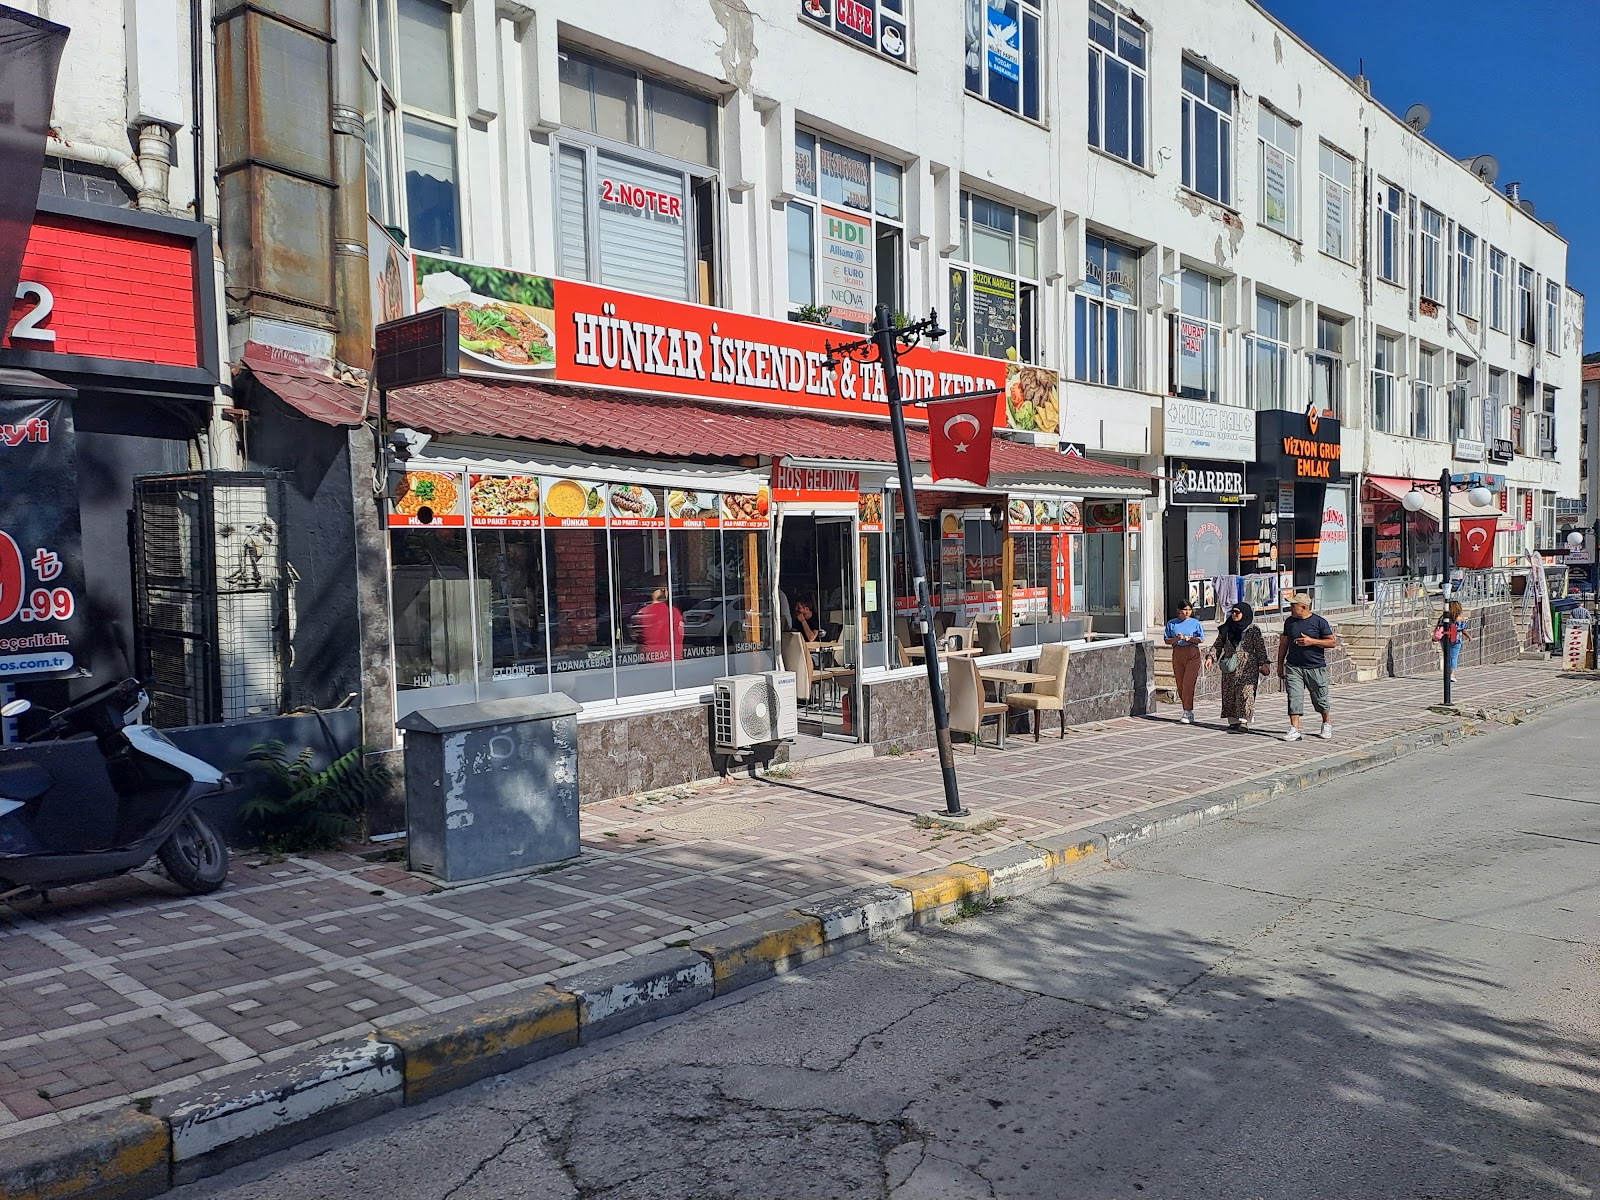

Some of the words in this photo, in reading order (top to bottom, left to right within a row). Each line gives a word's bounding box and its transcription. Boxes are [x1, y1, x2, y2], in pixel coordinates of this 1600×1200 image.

[837, 0, 873, 39] CAFE
[602, 179, 682, 218] 2.NOTER
[829, 218, 864, 245] HDI
[830, 244, 855, 260] Allianz
[844, 266, 864, 279] EURO
[973, 272, 992, 287] BOZOK
[12, 281, 57, 342] 2
[1182, 322, 1206, 339] MURAT
[574, 302, 706, 380] HÜNKAR
[709, 322, 836, 398] İSKENDER
[839, 354, 857, 400] &
[1179, 404, 1217, 429] MURAT
[1284, 436, 1318, 458] VİZYON
[1319, 442, 1341, 460] GRUP
[1297, 458, 1330, 478] EMLAK
[778, 468, 802, 497] HOŞ
[1188, 470, 1243, 494] BARBER
[473, 517, 486, 526] ALO
[487, 518, 507, 526] PAKET
[511, 519, 522, 527] 217
[523, 519, 532, 527] 30
[561, 518, 589, 527] HÜNKAR
[611, 519, 622, 527] ALO
[618, 653, 645, 665] TANDIR
[646, 650, 670, 662] KEBAP
[683, 647, 706, 658] TAVUK
[505, 663, 536, 677] DÖNER
[556, 658, 585, 672] ADANA
[585, 657, 611, 670] KEBAP
[413, 672, 455, 687] HÜNKAR
